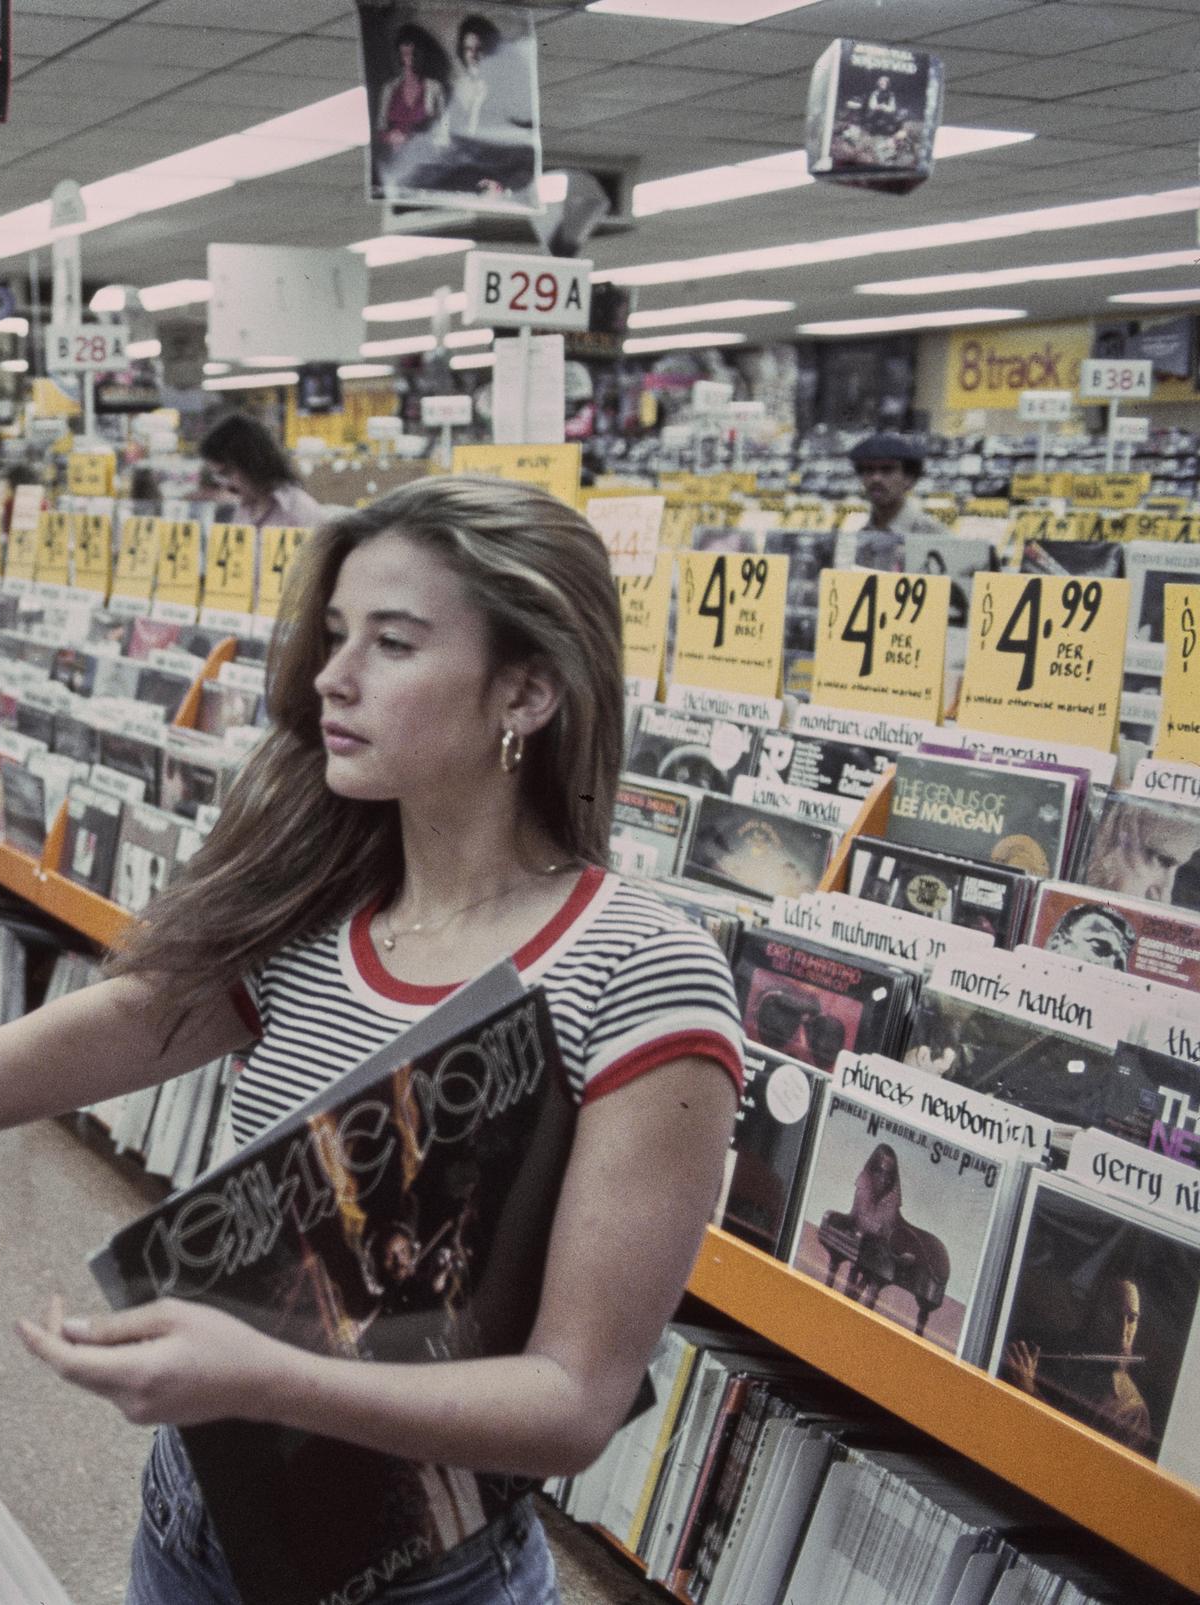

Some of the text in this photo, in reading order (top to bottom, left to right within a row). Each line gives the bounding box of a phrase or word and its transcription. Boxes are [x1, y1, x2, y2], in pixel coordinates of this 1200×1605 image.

[484, 270, 582, 312] B 29 A
[75, 336, 106, 362] 28
[1105, 368, 1134, 391] 38
[890, 633, 912, 649] PER
[1056, 642, 1083, 661] PER
[884, 649, 921, 669] DISC!
[1049, 659, 1094, 682] DISC!
[925, 782, 982, 809] GENIUS
[983, 793, 1006, 813] OF
[893, 795, 1005, 834] LEE MORGAN
[784, 902, 822, 931] idris
[950, 969, 1092, 1030] morris nanton
[842, 1060, 914, 1107] phineas
[1092, 1151, 1163, 1205] gerry
